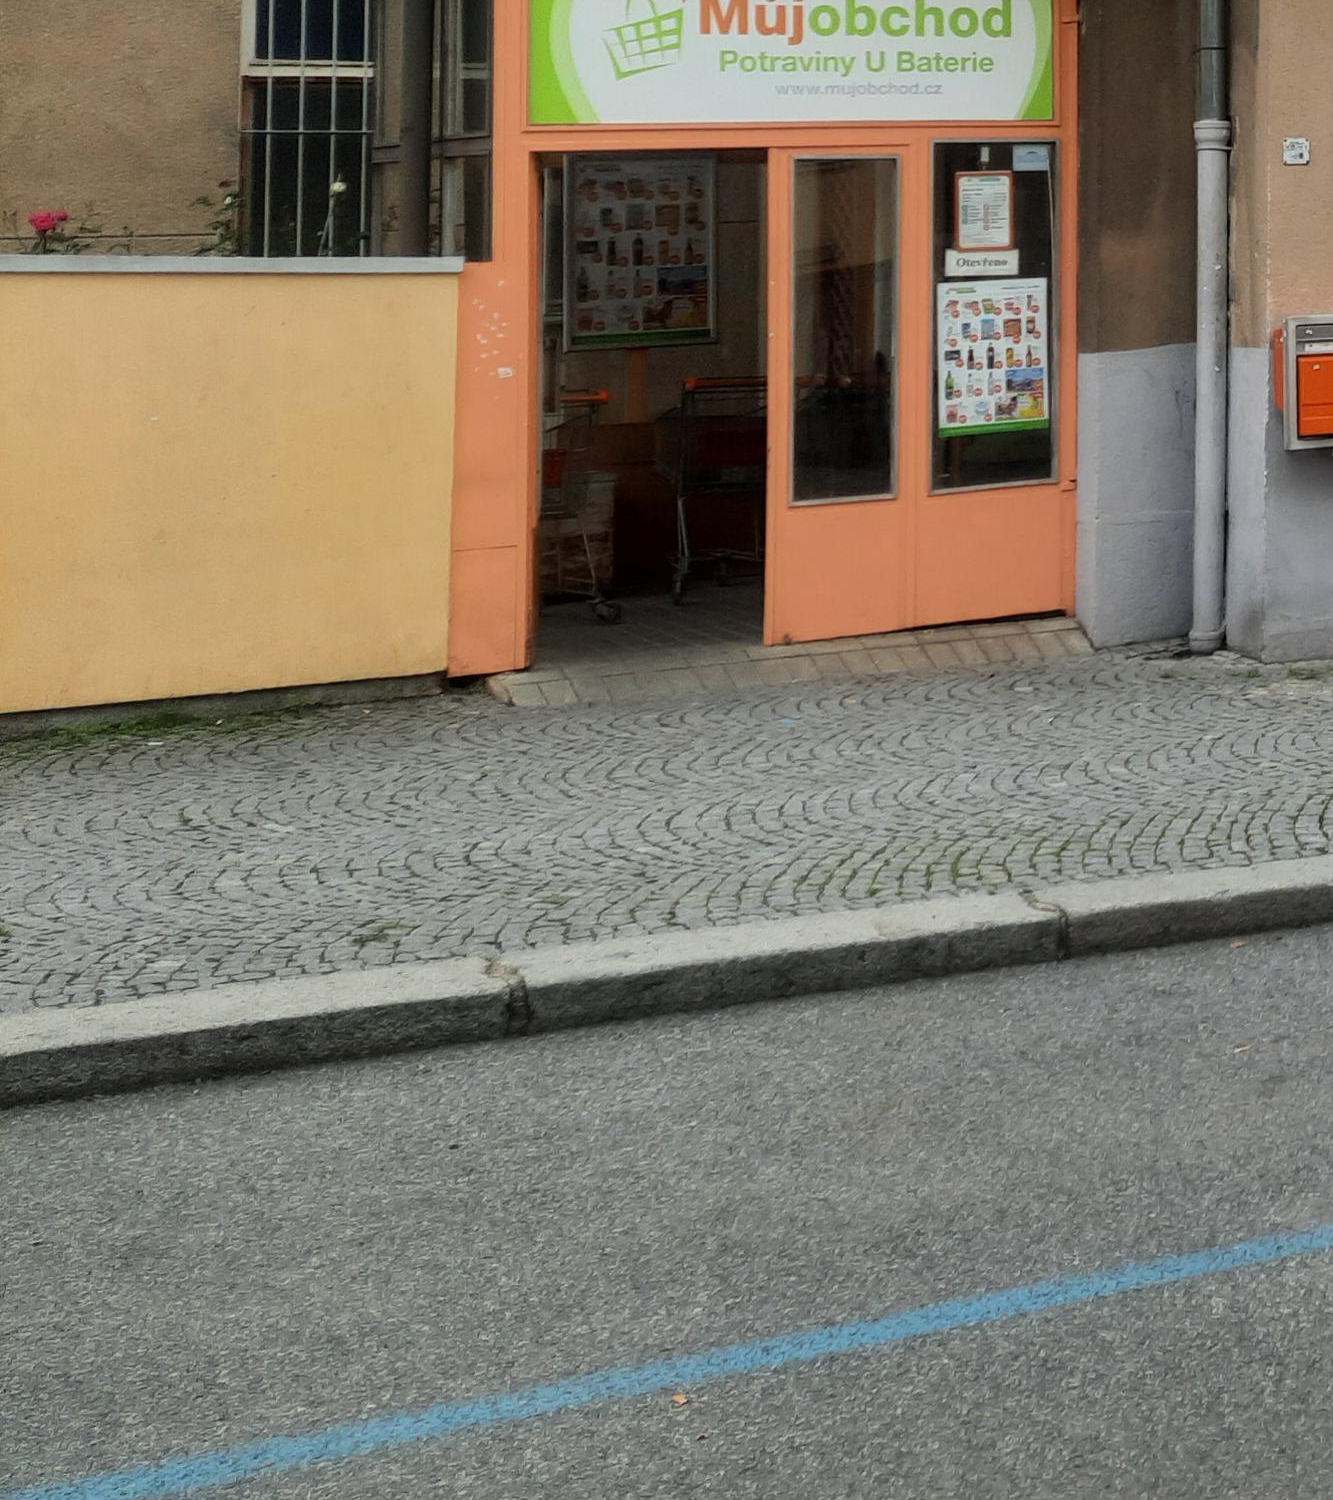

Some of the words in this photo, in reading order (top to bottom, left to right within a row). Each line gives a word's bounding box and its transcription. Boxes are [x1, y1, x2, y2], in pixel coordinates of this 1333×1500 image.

[719, 50, 856, 77] Potraviny
[865, 51, 886, 72] U
[896, 51, 995, 73] Baterie
[774, 81, 944, 97] www.mujobchod.cz
[956, 257, 1008, 268] Otevřeno
